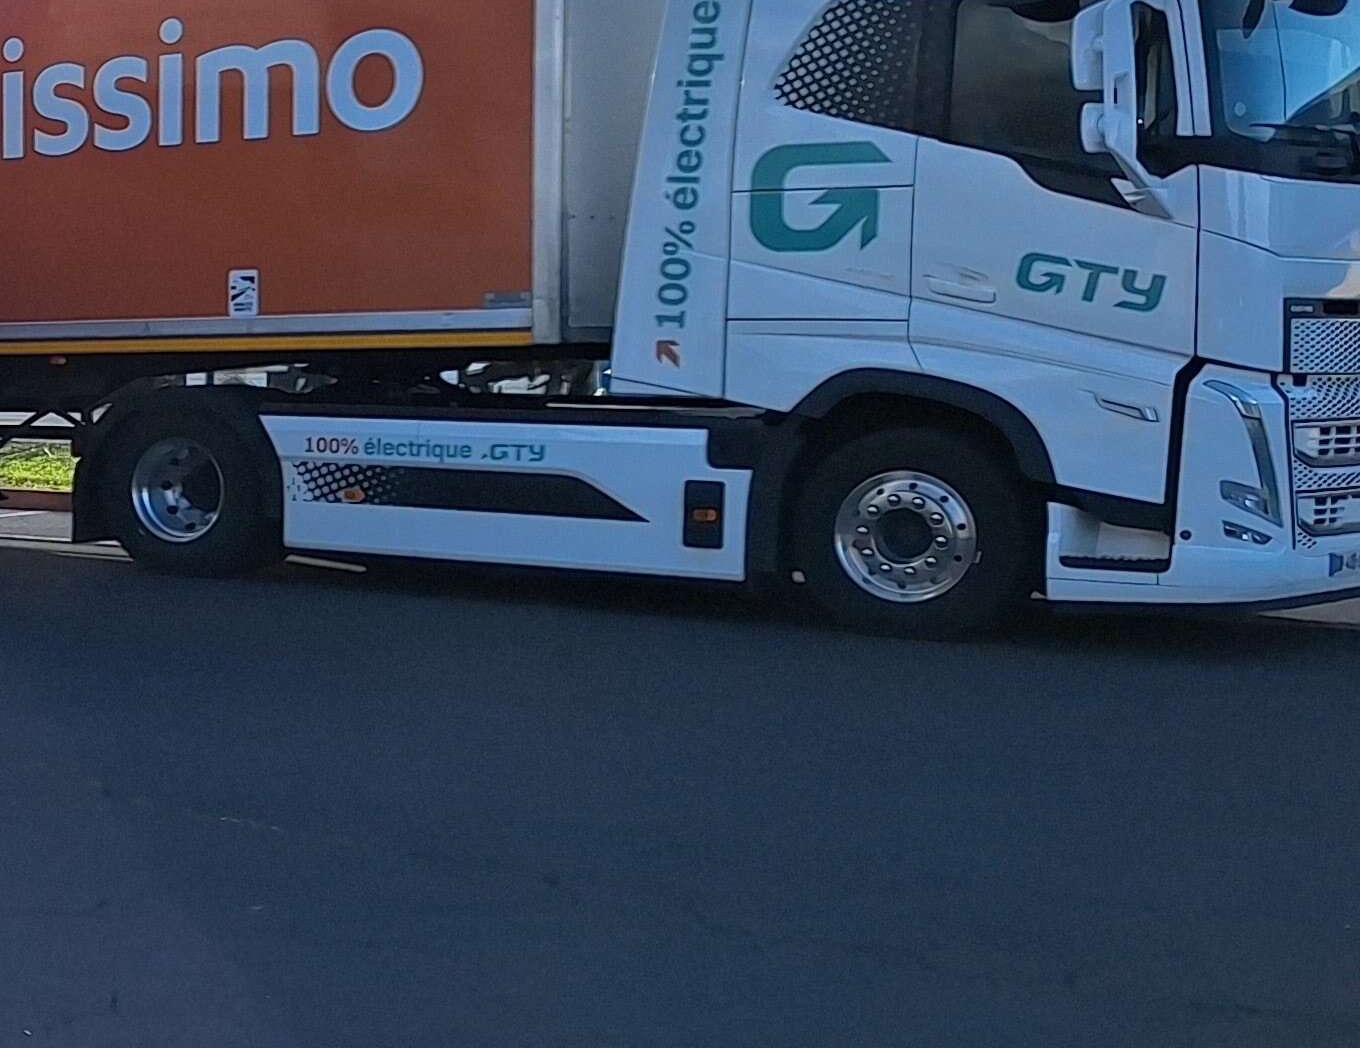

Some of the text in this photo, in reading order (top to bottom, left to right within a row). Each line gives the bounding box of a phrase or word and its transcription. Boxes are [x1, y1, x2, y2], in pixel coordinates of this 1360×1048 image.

[655, 0, 725, 329] 100% électrique
[1016, 252, 1167, 312] GTY
[304, 437, 359, 455] 100%
[363, 438, 472, 463] électrique
